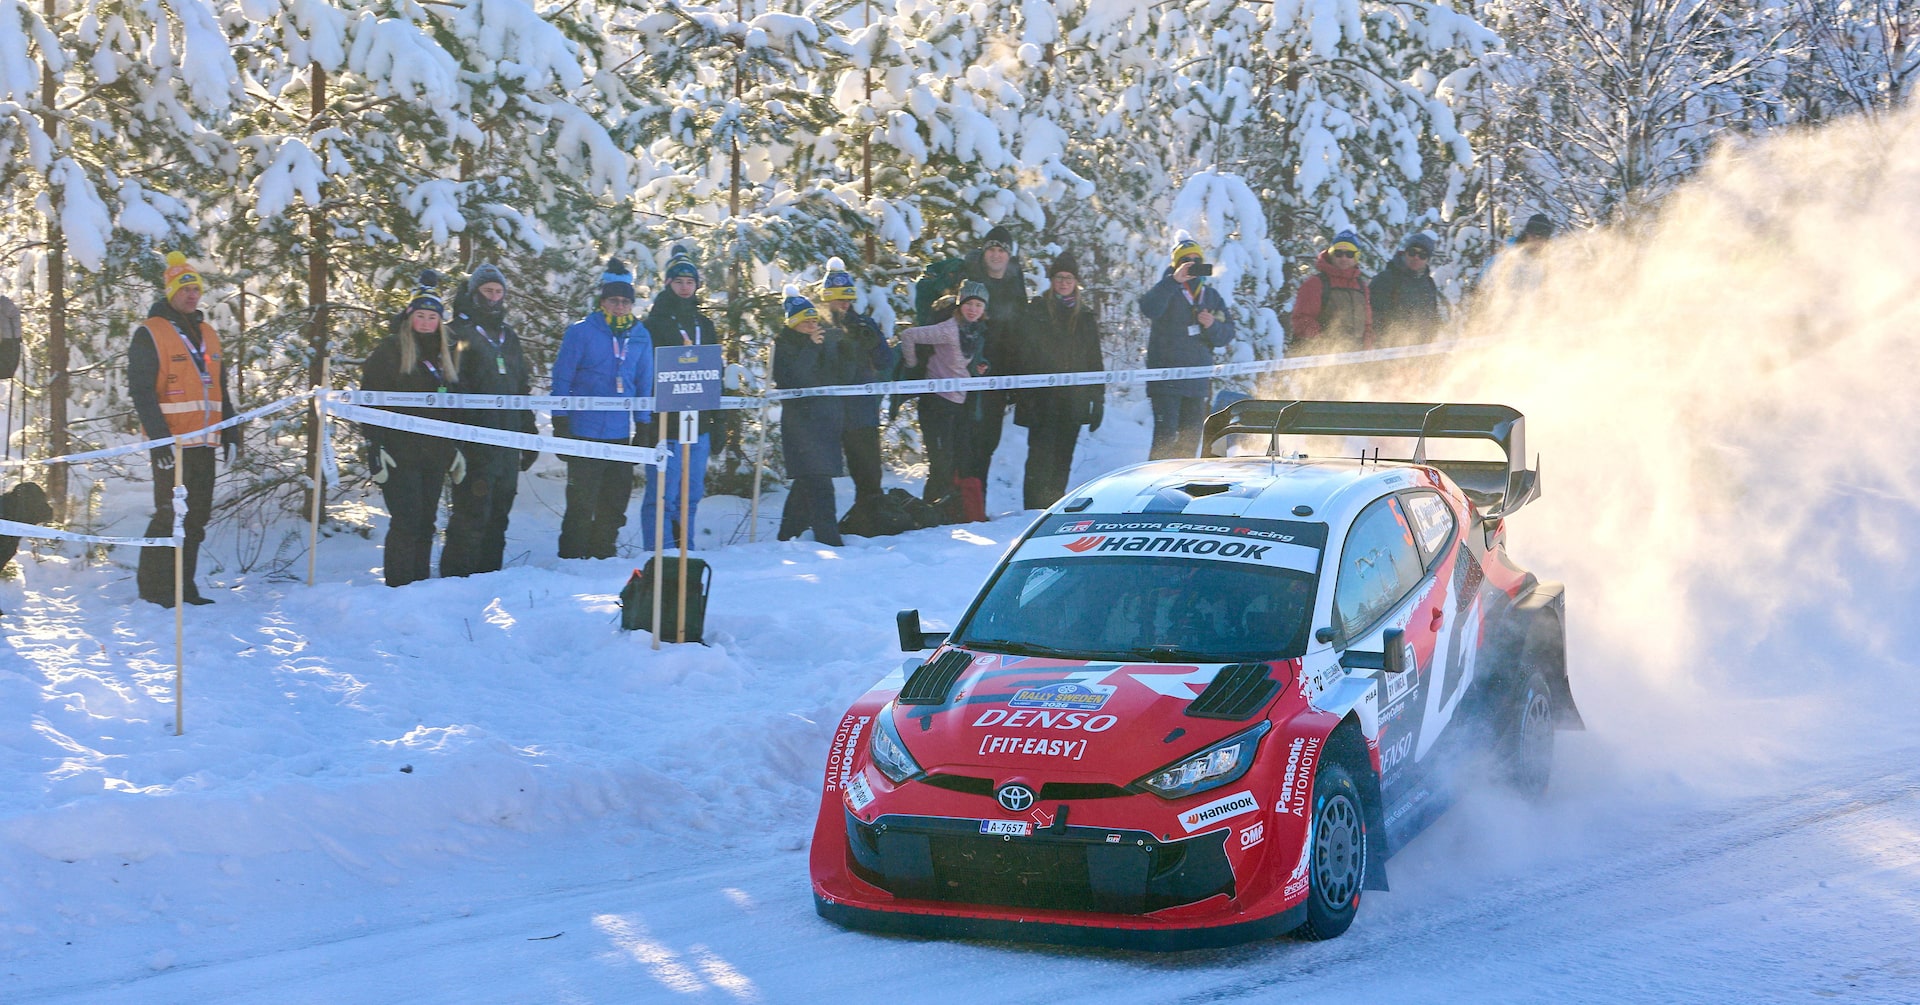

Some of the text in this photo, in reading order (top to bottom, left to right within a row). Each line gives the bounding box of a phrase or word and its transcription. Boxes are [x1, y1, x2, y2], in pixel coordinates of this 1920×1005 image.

[657, 369, 721, 383] SPECTATOR
[672, 382, 704, 395] AREA
[1057, 521, 1295, 543] GR TOYOTA GAZOO Racing
[1018, 690, 1105, 704] RALLY SWEDEN
[972, 709, 1119, 733] DENSO
[826, 714, 855, 792] AUTOMOTIVE
[839, 715, 871, 790] Panasonic
[1275, 737, 1305, 814] Panasonic
[1293, 737, 1321, 817] AUTOMOTIVE
[990, 821, 1024, 834] A-7657
[1240, 823, 1265, 847] OMP
